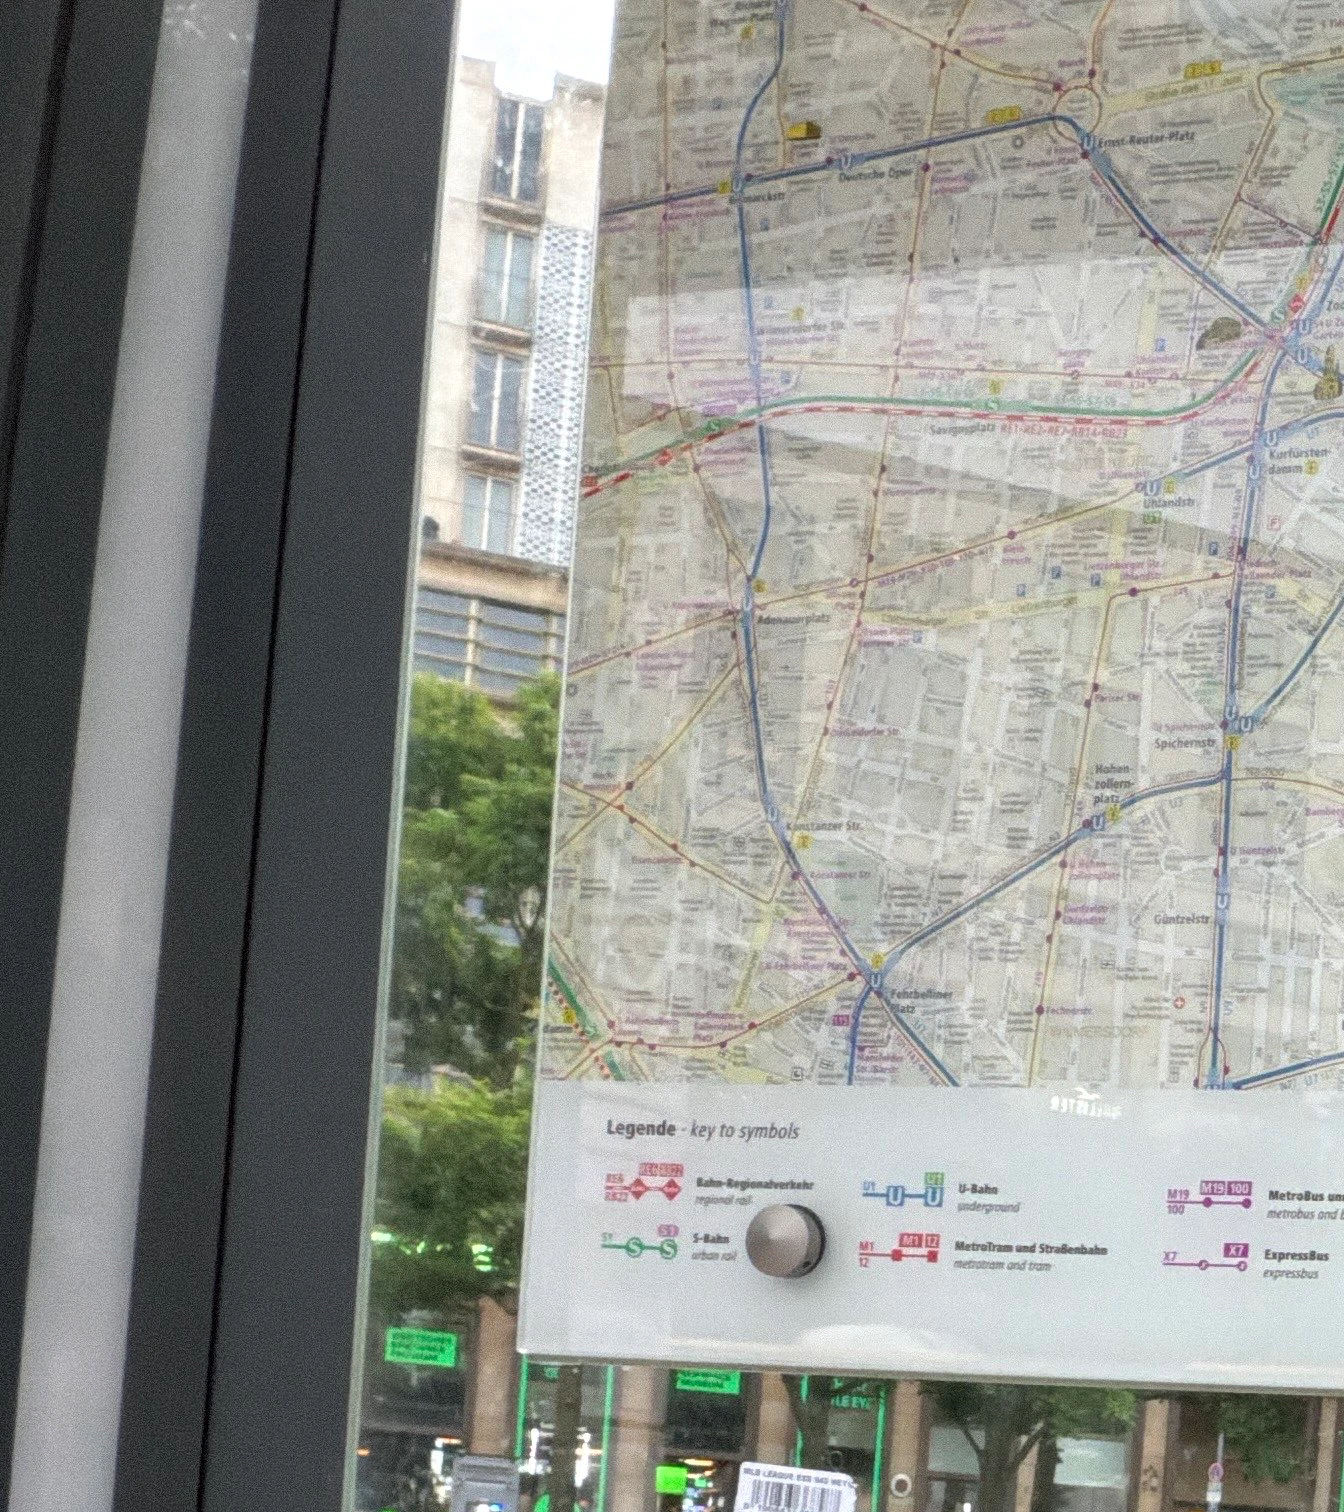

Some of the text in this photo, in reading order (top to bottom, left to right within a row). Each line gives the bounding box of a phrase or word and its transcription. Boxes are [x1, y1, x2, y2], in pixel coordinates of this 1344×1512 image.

[1099, 131, 1195, 149] Ernst-Reuter-Platz
[1269, 463, 1302, 475] damm
[1093, 793, 1122, 805] platz
[890, 989, 953, 1000] Fehrbelliner
[606, 1120, 676, 1139] Legende
[690, 1120, 713, 1142] key
[720, 1122, 734, 1137] to
[738, 1123, 799, 1142] symbols
[959, 1184, 998, 1194] U-Bahn
[1202, 1182, 1249, 1194] M19 100
[1167, 1190, 1190, 1199] M19
[1269, 1191, 1324, 1202] MetroBus
[958, 1202, 1020, 1213] underground
[1168, 1205, 1184, 1215] 100
[1267, 1210, 1314, 1220] metrobus
[1318, 1209, 1338, 1220] and
[693, 1233, 730, 1244] S-Bahn
[859, 1242, 873, 1250] M1
[955, 1242, 1013, 1253] MetroTram
[1016, 1244, 1036, 1253] und
[1229, 1245, 1243, 1256] X7
[1163, 1252, 1177, 1262] X7
[1265, 1250, 1329, 1262] ExpressBus
[1007, 1260, 1025, 1270] and
[1263, 1269, 1319, 1280] expressbus
